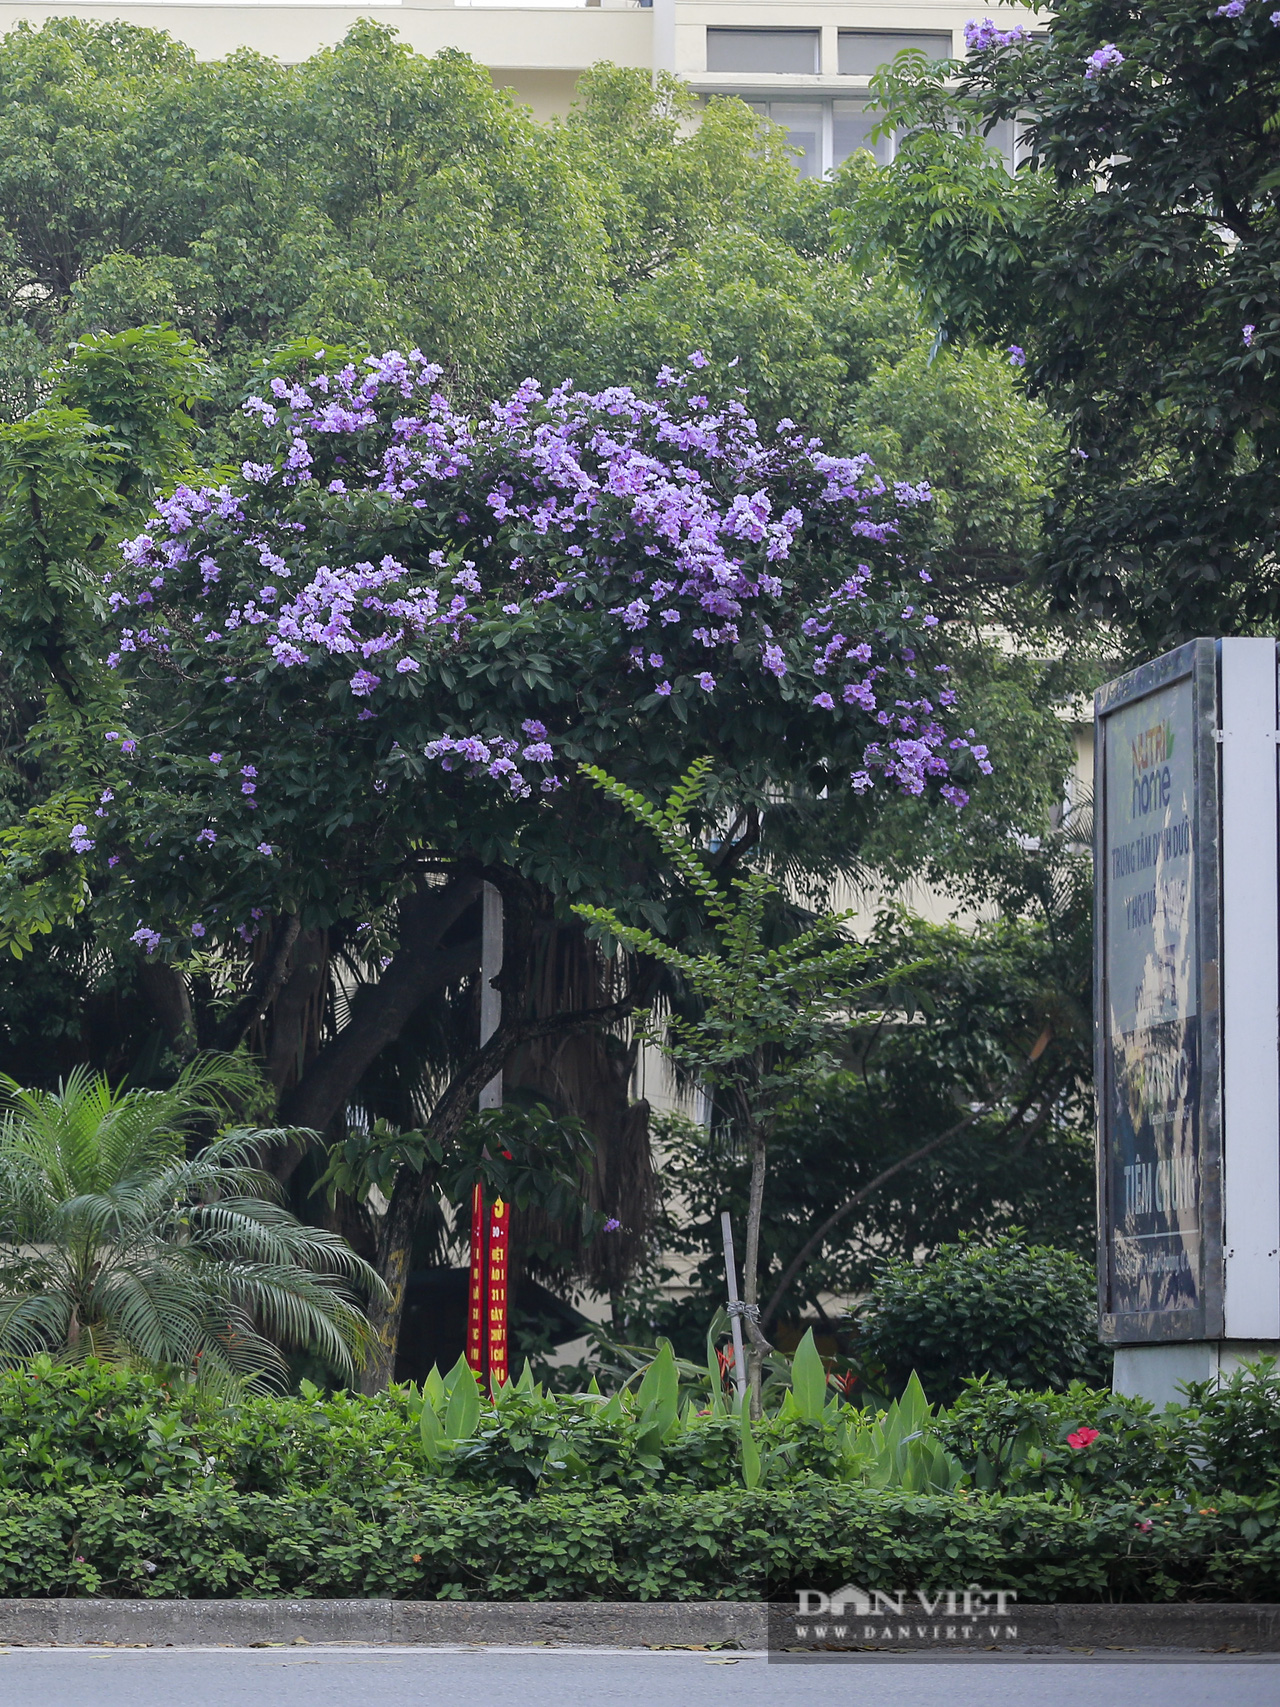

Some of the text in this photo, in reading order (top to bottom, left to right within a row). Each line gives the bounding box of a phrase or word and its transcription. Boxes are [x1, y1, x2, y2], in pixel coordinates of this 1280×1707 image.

[1131, 761, 1171, 819] home
[1111, 842, 1135, 880] TRUNG
[1136, 832, 1152, 872] TÂM
[1123, 1142, 1195, 1215] TIÊM CHỦNG
